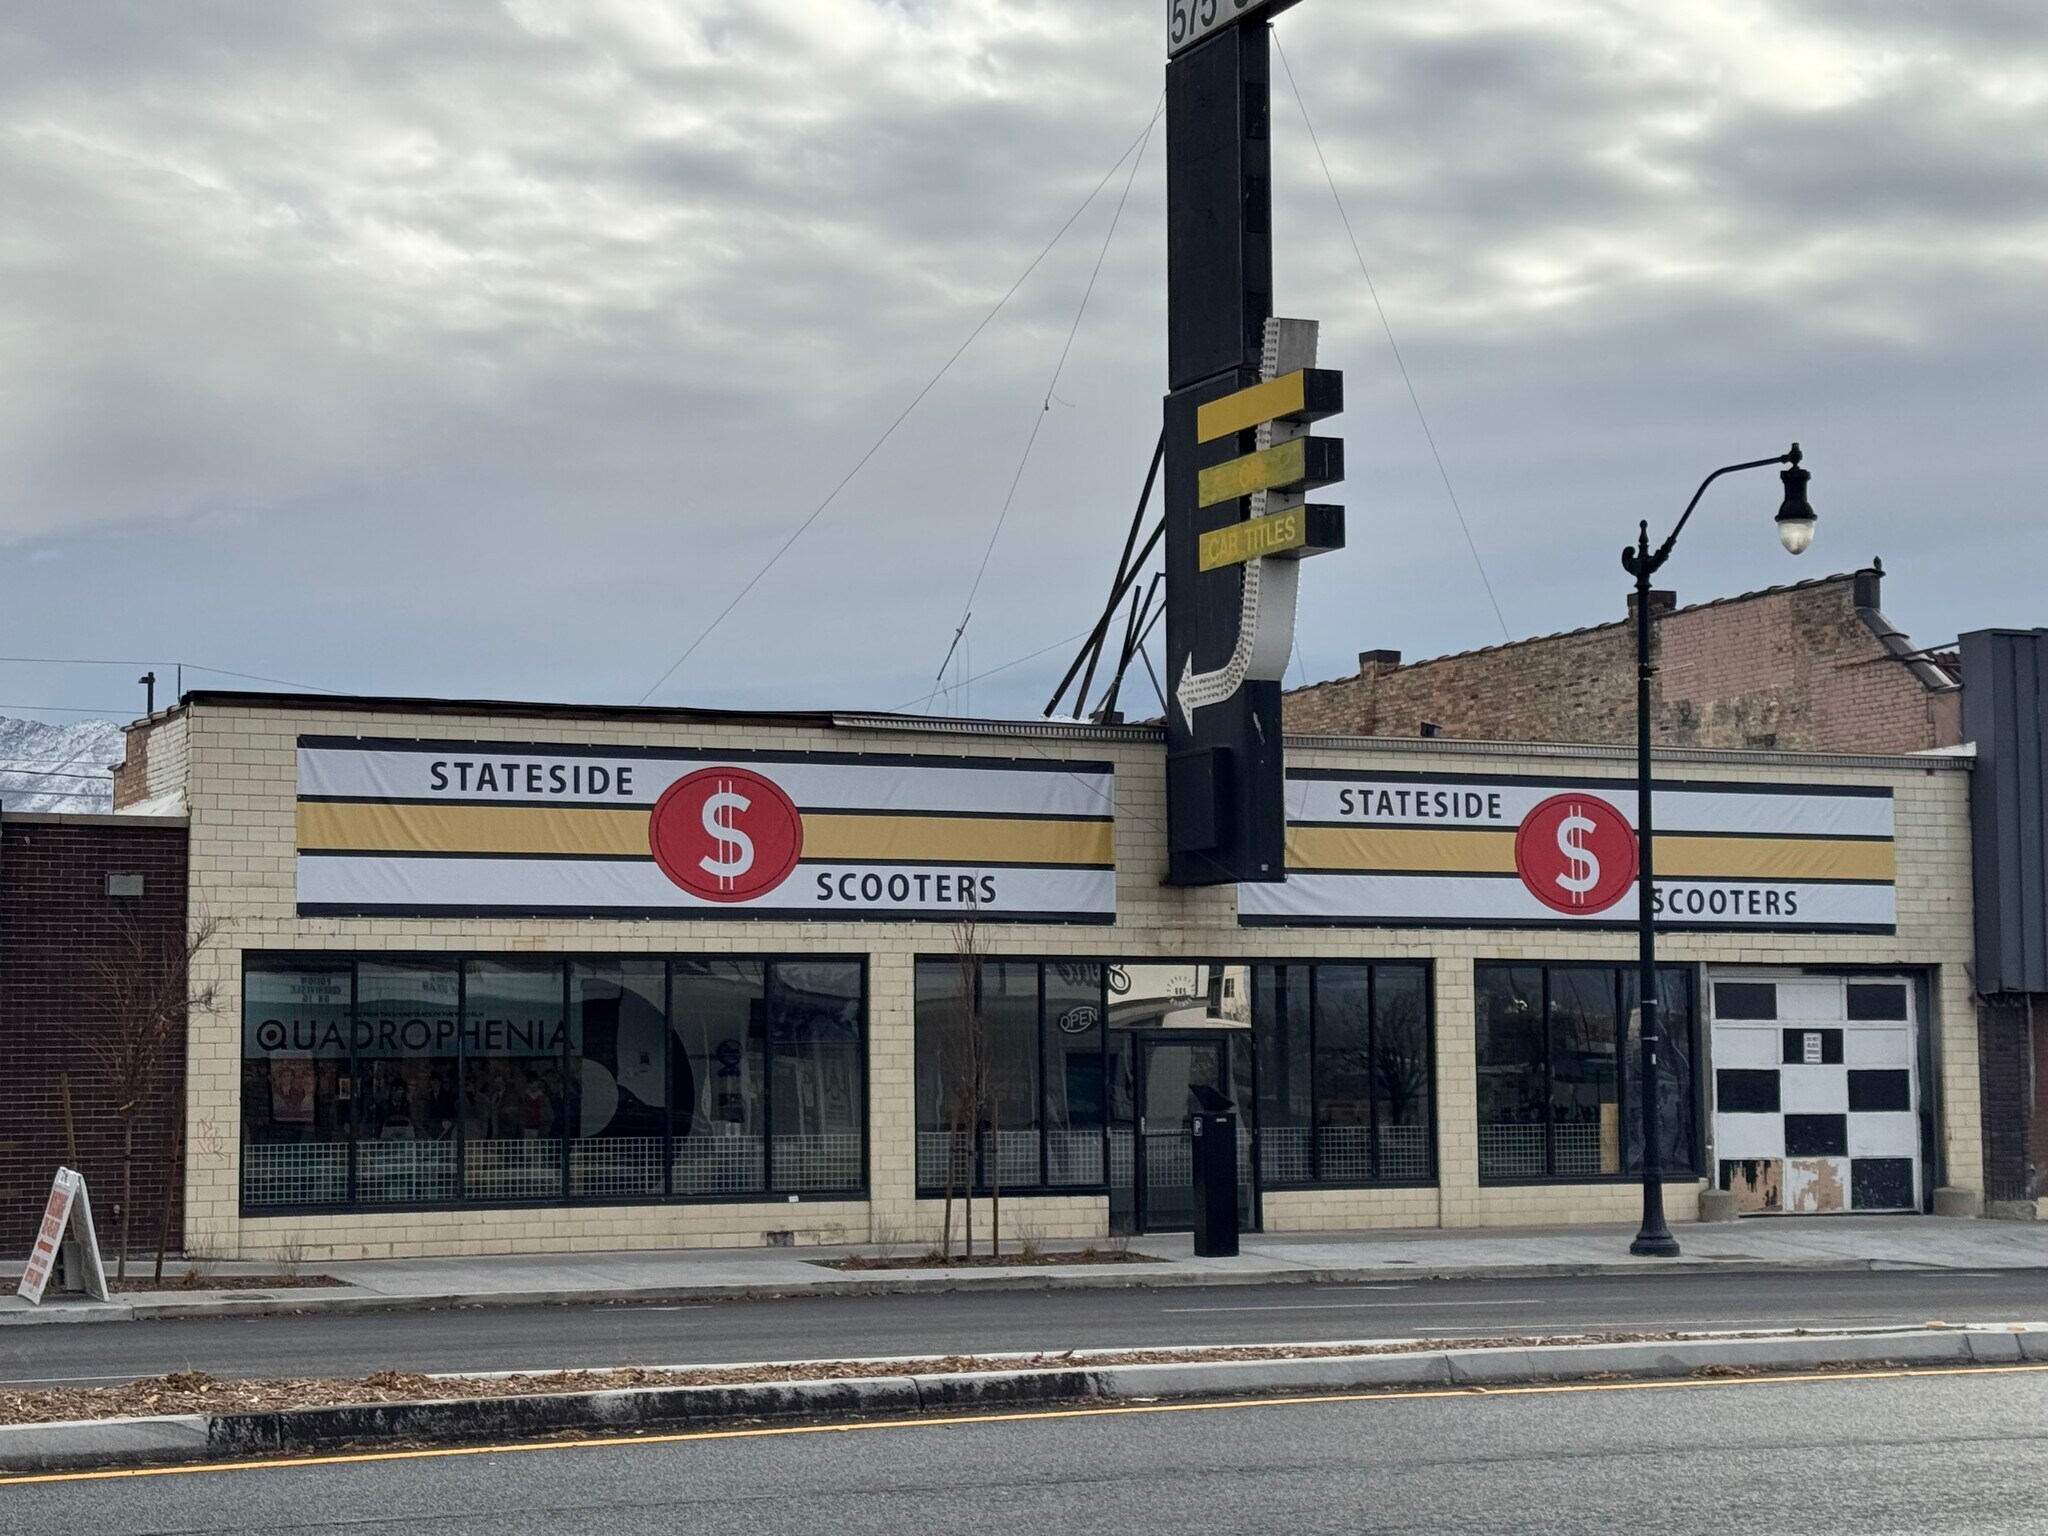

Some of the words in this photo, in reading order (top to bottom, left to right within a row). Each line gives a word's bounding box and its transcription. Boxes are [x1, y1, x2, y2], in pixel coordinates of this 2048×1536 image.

[1208, 531, 1237, 562] CAR
[1244, 516, 1297, 549] TITLES
[430, 761, 634, 796] STATESIDE
[1339, 788, 1502, 820] STATESIDE
[816, 873, 997, 904] SCOOTERS
[1653, 887, 1798, 916] SCOOTERS
[1060, 1008, 1098, 1030] OPEN
[256, 1019, 575, 1052] QUADROPHENIA
